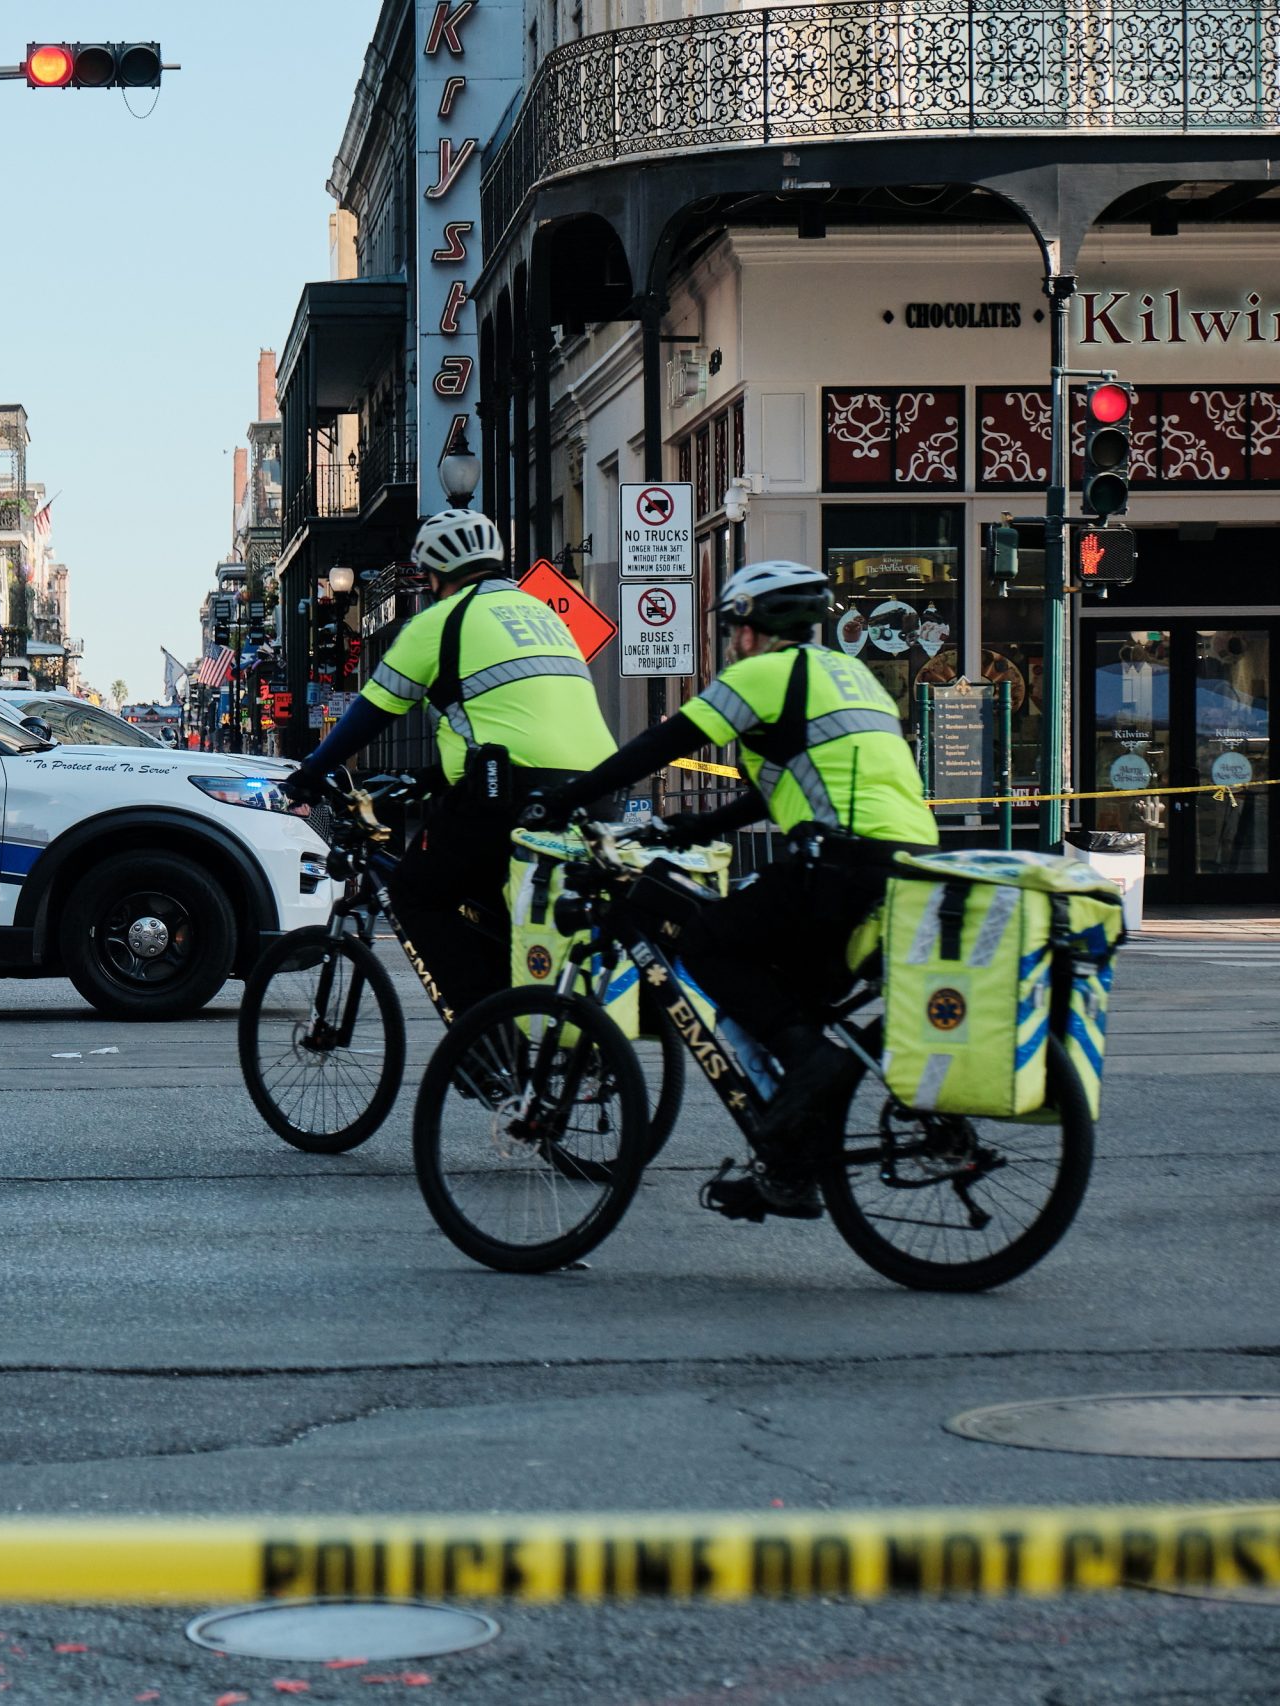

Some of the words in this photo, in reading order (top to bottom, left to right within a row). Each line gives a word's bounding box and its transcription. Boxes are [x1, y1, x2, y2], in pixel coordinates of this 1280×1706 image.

[905, 303, 1021, 328] CHOCOLATES
[1075, 288, 1280, 344] Kilwi
[625, 530, 640, 541] NO
[645, 530, 689, 541] TRUCKS
[627, 564, 654, 572] MINIMUM
[547, 598, 569, 613] AD
[501, 620, 577, 649] EMS
[640, 632, 674, 642] BUSES
[624, 645, 651, 655] LONGER
[652, 645, 671, 655] THAN
[673, 644, 680, 654] 31
[683, 644, 690, 654] FT
[638, 657, 677, 668] PROHIBITED
[1114, 730, 1150, 739] Kilwins
[1215, 728, 1250, 737] Kilwins
[52, 760, 93, 771] Protect
[95, 763, 117, 772] and
[120, 763, 134, 773] To
[667, 996, 729, 1080] EMS
[264, 1538, 528, 1598] POLICE
[561, 1536, 716, 1598] LINE
[752, 1534, 852, 1597] DO
[886, 1532, 1024, 1595] NOT
[1063, 1526, 1280, 1589] CROS
